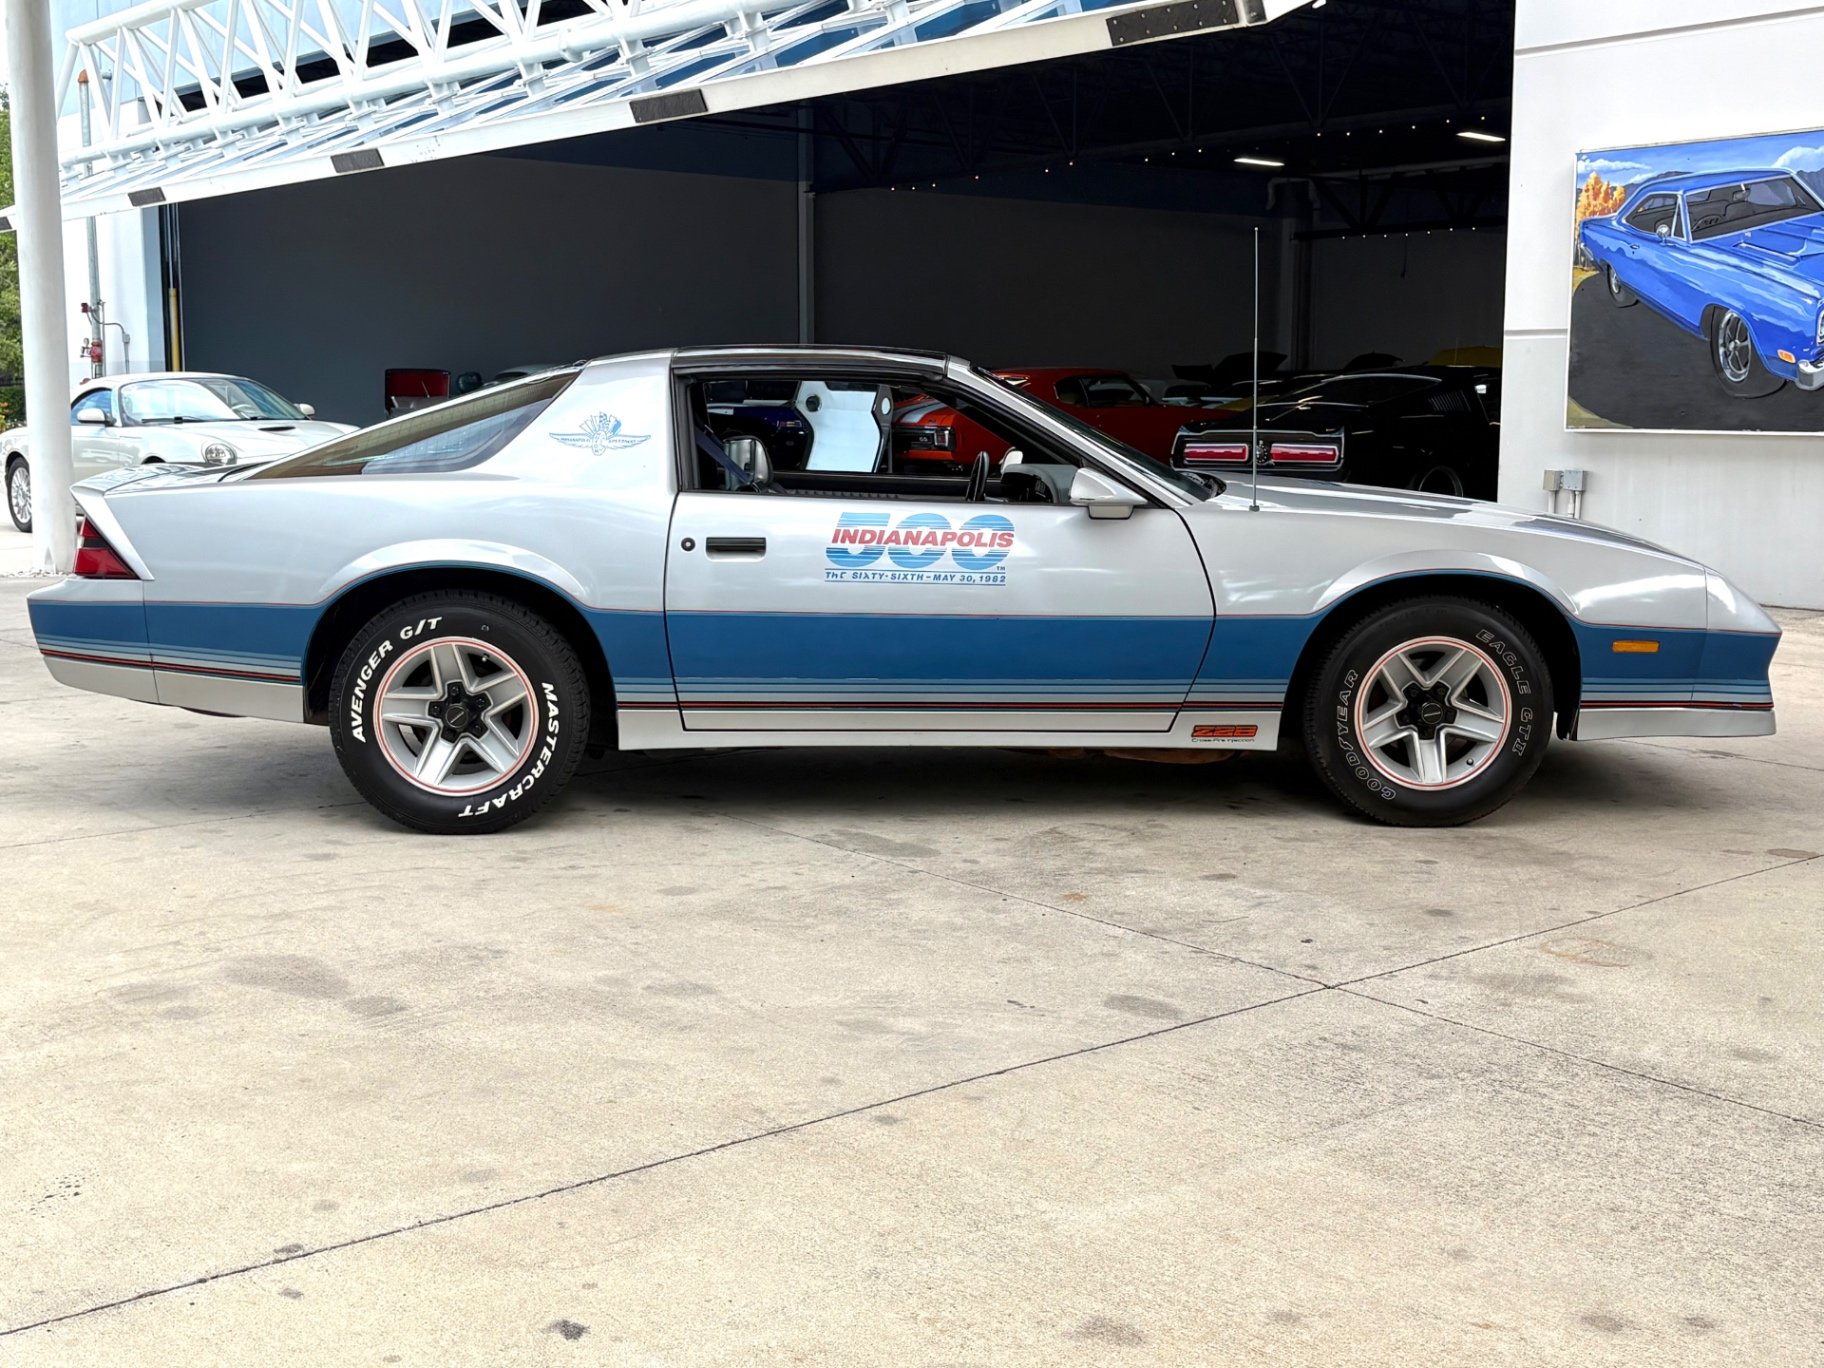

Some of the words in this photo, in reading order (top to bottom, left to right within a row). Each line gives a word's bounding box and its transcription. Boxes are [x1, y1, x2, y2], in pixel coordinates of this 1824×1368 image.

[825, 511, 1015, 571] 500
[831, 528, 1015, 548] INDIANAPOLIS
[959, 575, 976, 583] 30,
[351, 639, 394, 743] AVENGER
[400, 616, 442, 640] G/T
[1475, 628, 1532, 696] EAGLE
[458, 682, 560, 818] MASTERCRAFT
[1336, 668, 1397, 800] GOODYEAR
